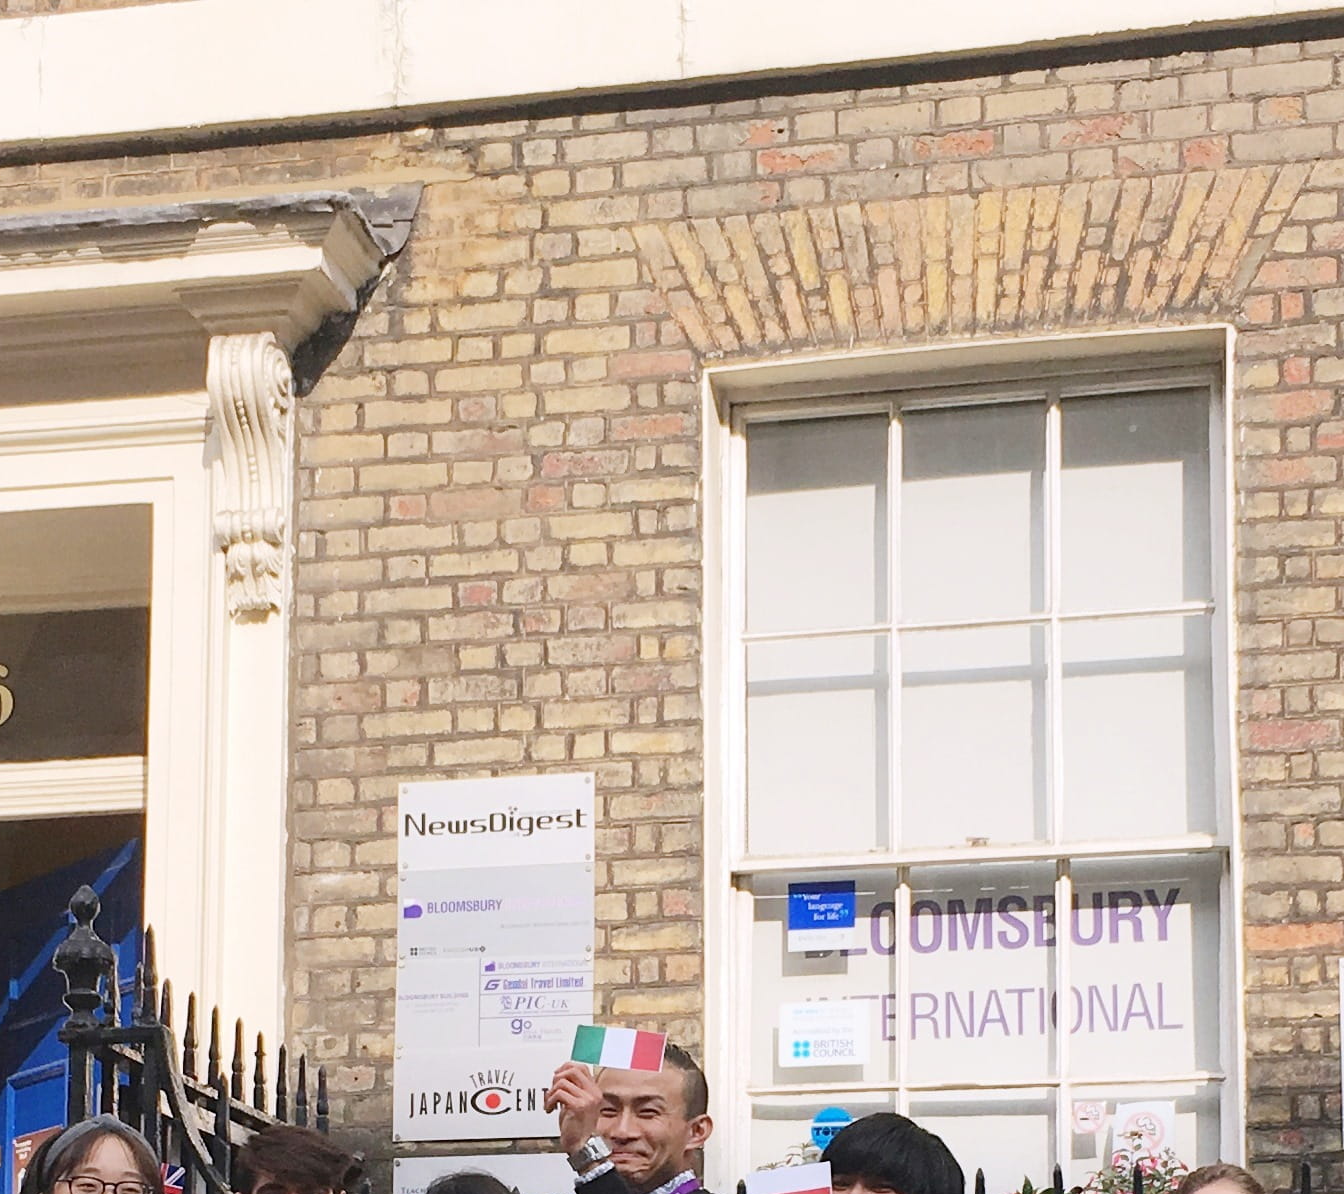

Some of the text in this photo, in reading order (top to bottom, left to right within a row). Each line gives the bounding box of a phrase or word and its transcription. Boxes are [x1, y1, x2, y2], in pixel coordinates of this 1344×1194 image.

[404, 806, 588, 837] NewsDigest
[427, 900, 504, 915] BLOOMSBURY
[813, 1039, 854, 1049] BRITISH
[812, 1048, 856, 1058] COUNCIL
[469, 1069, 516, 1089] TRAVEL
